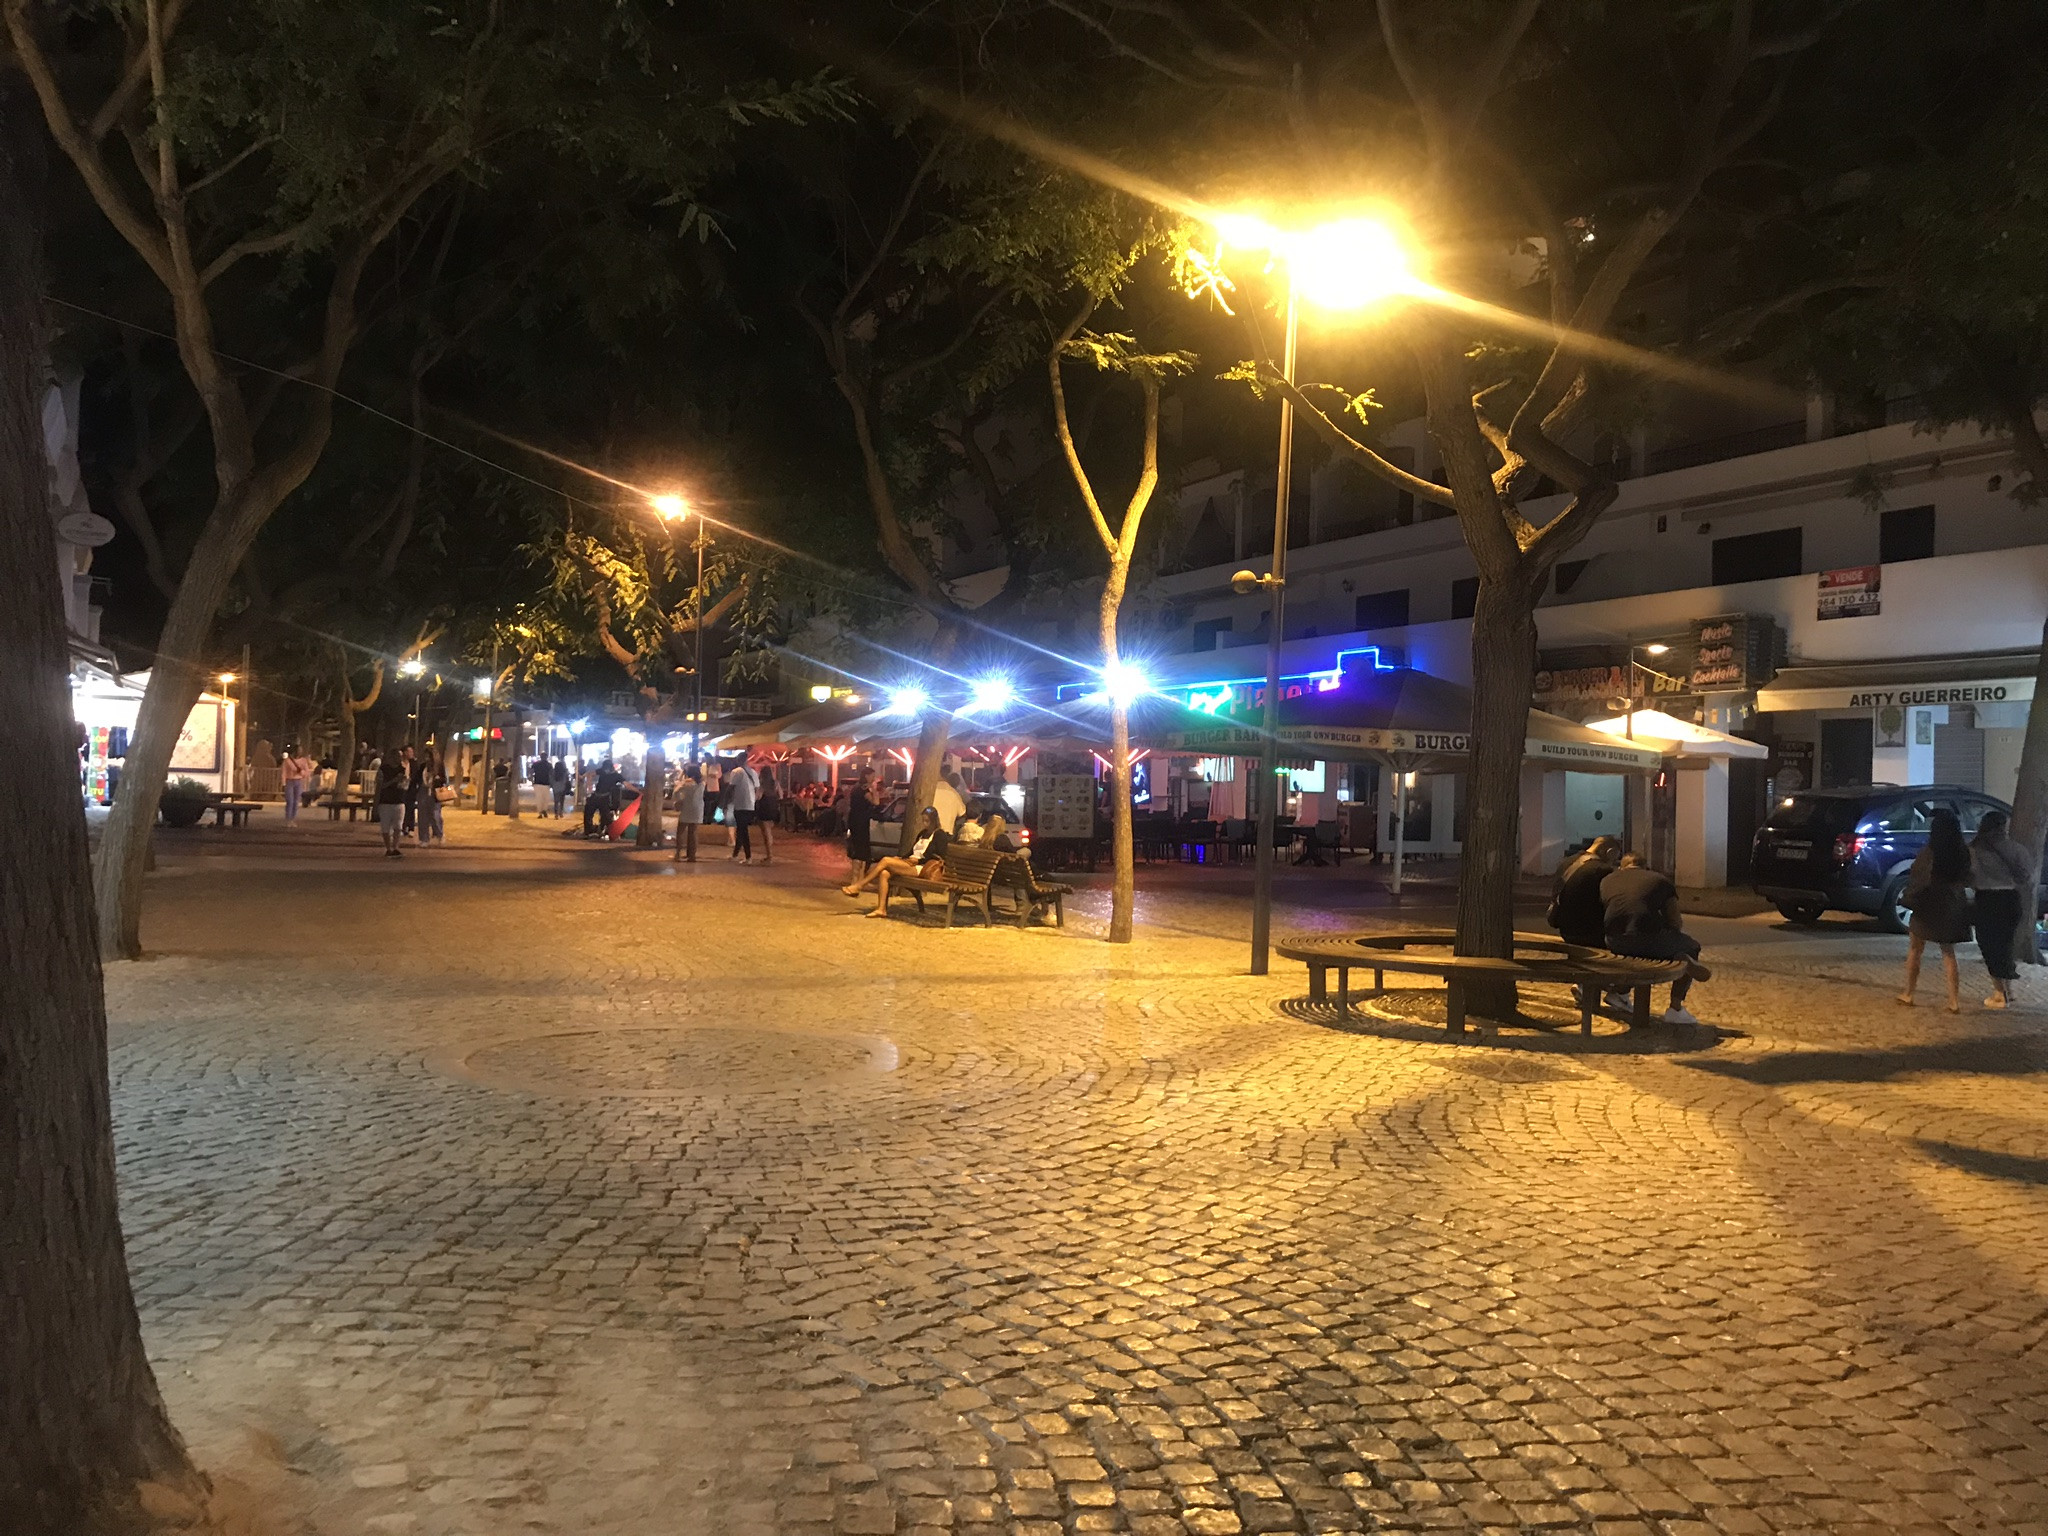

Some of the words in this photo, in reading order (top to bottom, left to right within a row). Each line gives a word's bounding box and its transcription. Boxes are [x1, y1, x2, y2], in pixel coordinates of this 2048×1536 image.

[1835, 570, 1864, 584] VENDE
[1817, 598, 1835, 610] 964
[1839, 594, 1856, 606] 130
[1859, 592, 1879, 603] 432
[1652, 671, 1686, 693] Bar
[1850, 692, 1895, 707] ARTY
[1899, 686, 2007, 704] GUERREIRO
[1184, 729, 1231, 746] BURGER
[1234, 728, 1260, 743] BAR
[1313, 731, 1330, 741] OWN
[1331, 732, 1361, 743] BURGER
[1541, 744, 1566, 755] BUILD
[1566, 746, 1589, 757] YOUR
[1590, 749, 1608, 760] OWN
[1608, 751, 1639, 763] BURGER
